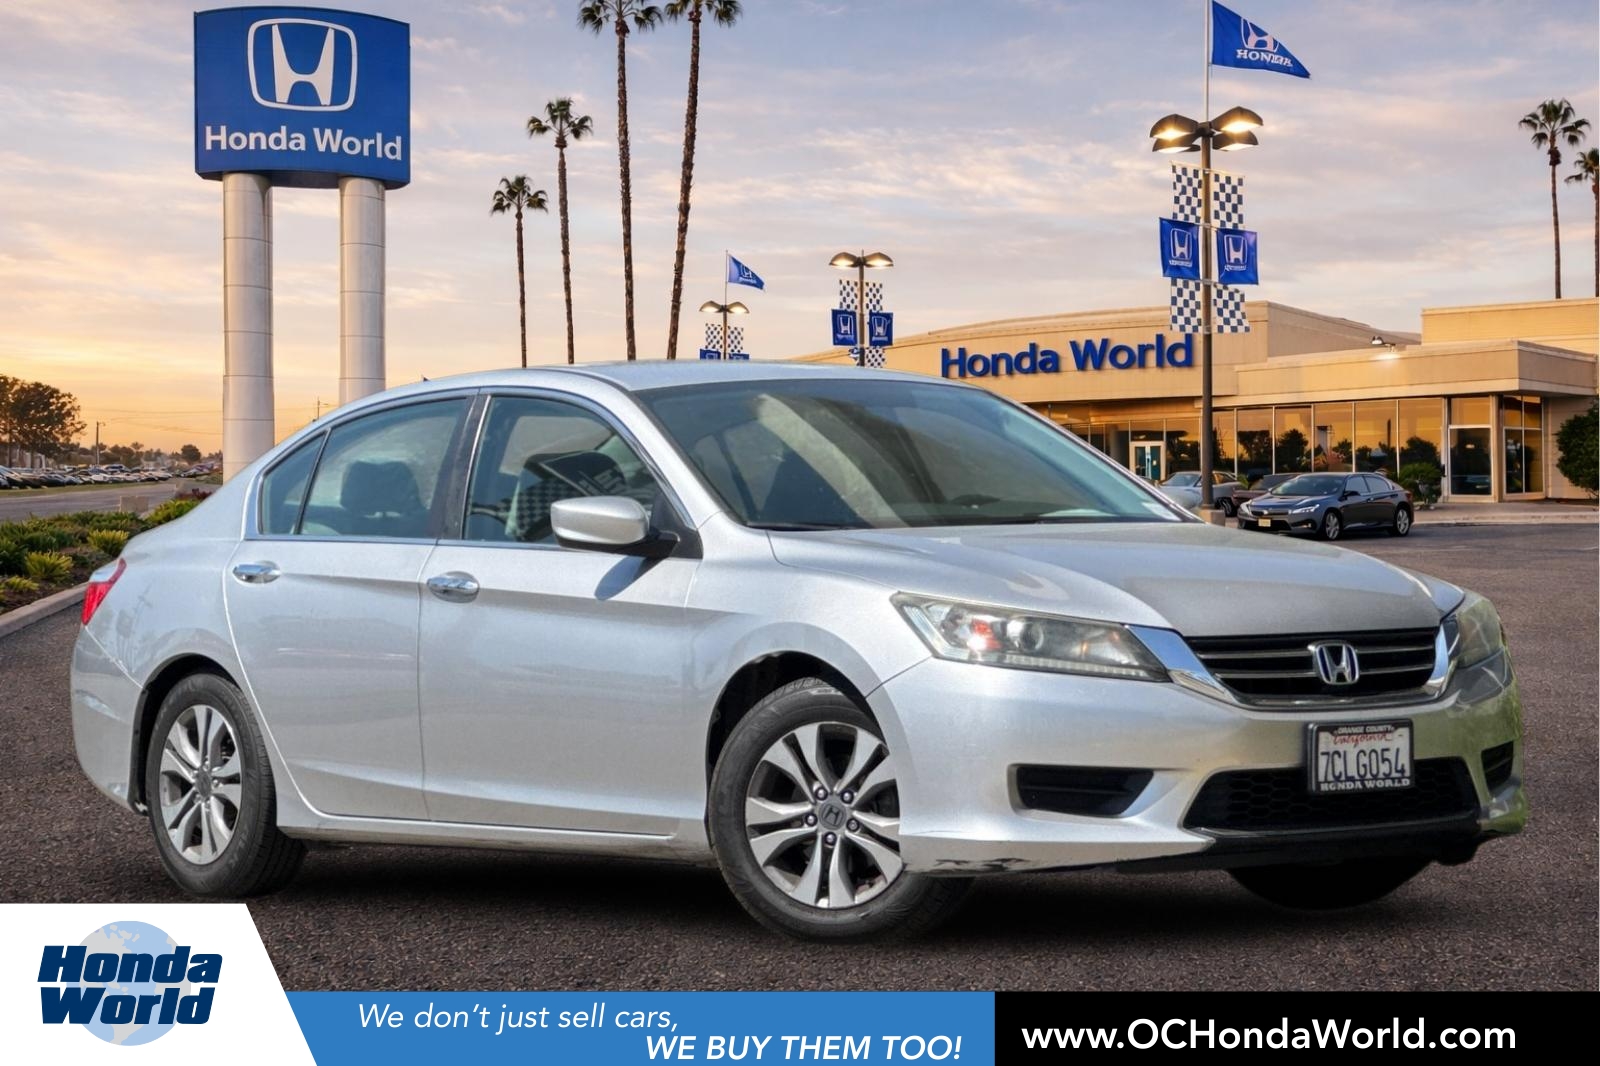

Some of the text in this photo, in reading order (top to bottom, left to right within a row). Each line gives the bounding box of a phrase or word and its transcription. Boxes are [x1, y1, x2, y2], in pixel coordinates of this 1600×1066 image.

[205, 125, 402, 161] Honda World
[941, 333, 1193, 377] Honda World
[1320, 748, 1406, 782] 7CLG054
[1321, 779, 1410, 792] HONDA WORLD
